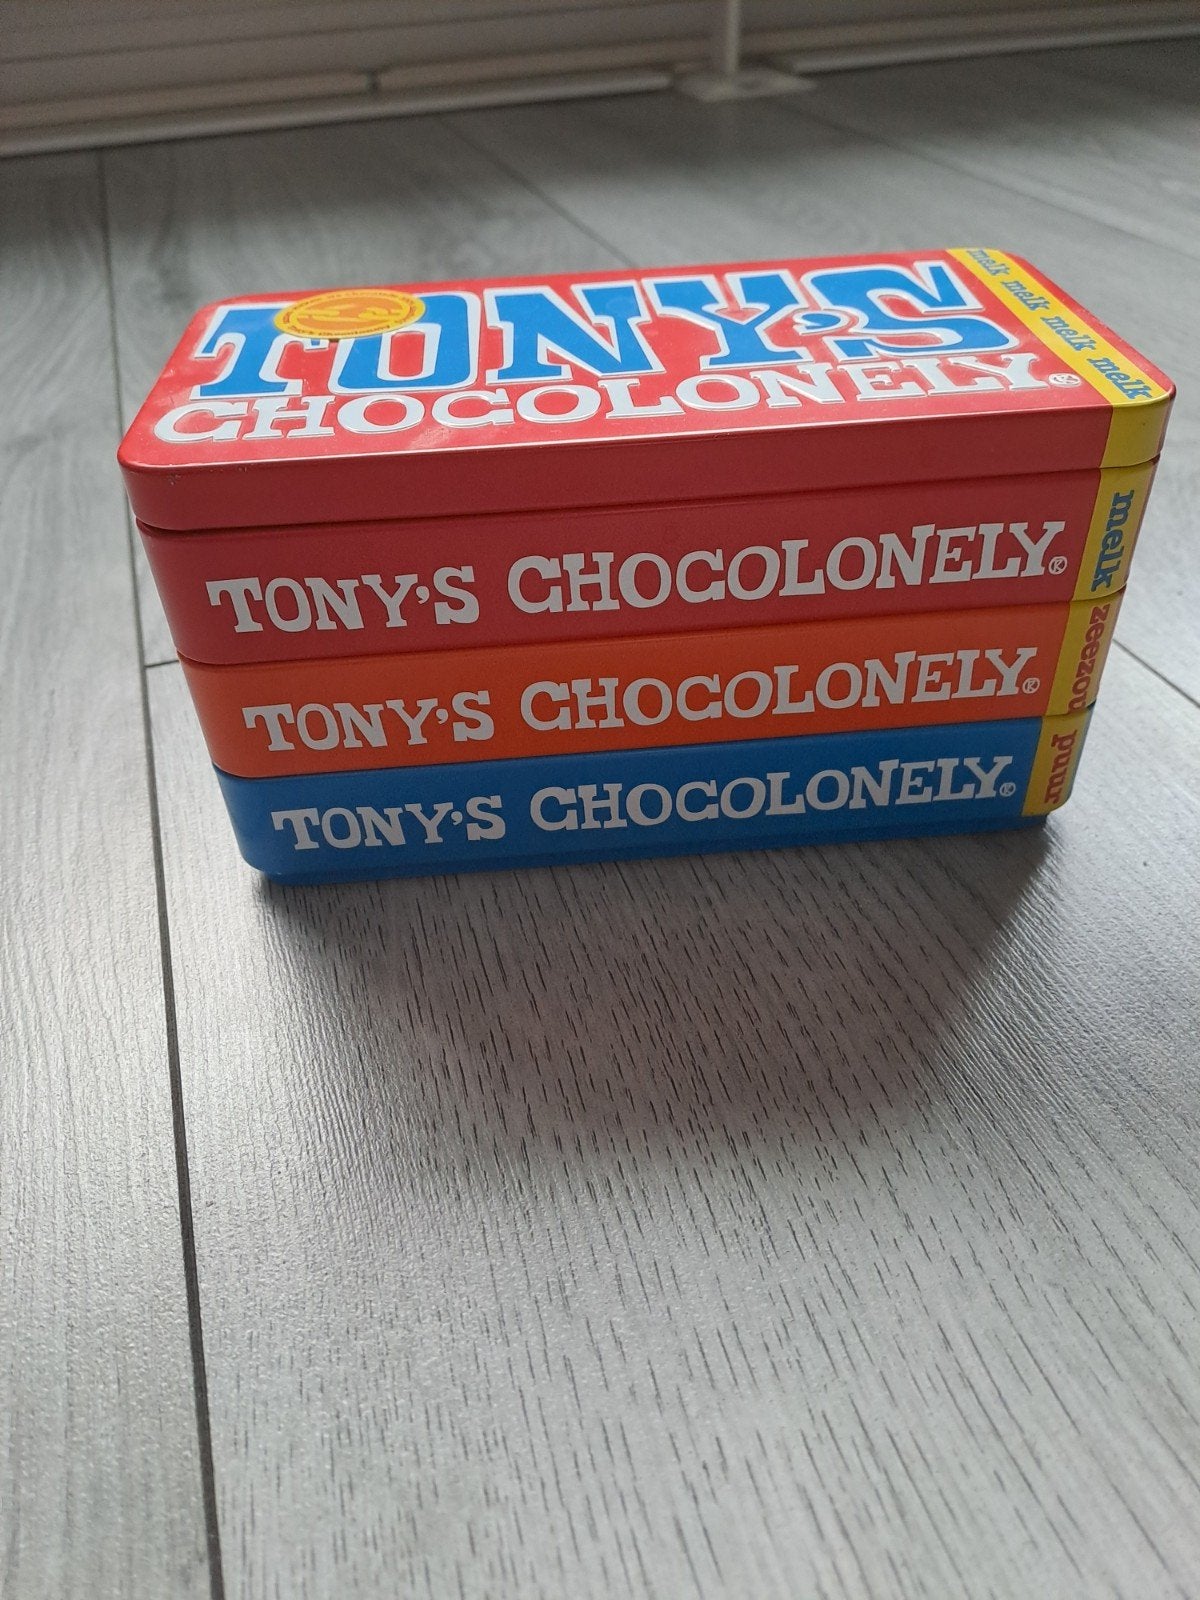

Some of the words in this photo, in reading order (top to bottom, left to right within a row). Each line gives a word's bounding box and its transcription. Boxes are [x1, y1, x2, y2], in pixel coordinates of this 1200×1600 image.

[190, 259, 1019, 401] TONY'S
[965, 247, 1010, 277] melk
[1001, 279, 1050, 312] melk
[1040, 315, 1098, 352] melk
[1087, 356, 1154, 400] melk
[1090, 488, 1135, 593] melk
[205, 565, 481, 634] TONY'S
[242, 690, 496, 753] TONY'S
[1044, 728, 1079, 805] puur
[271, 795, 506, 851] TONY'S
